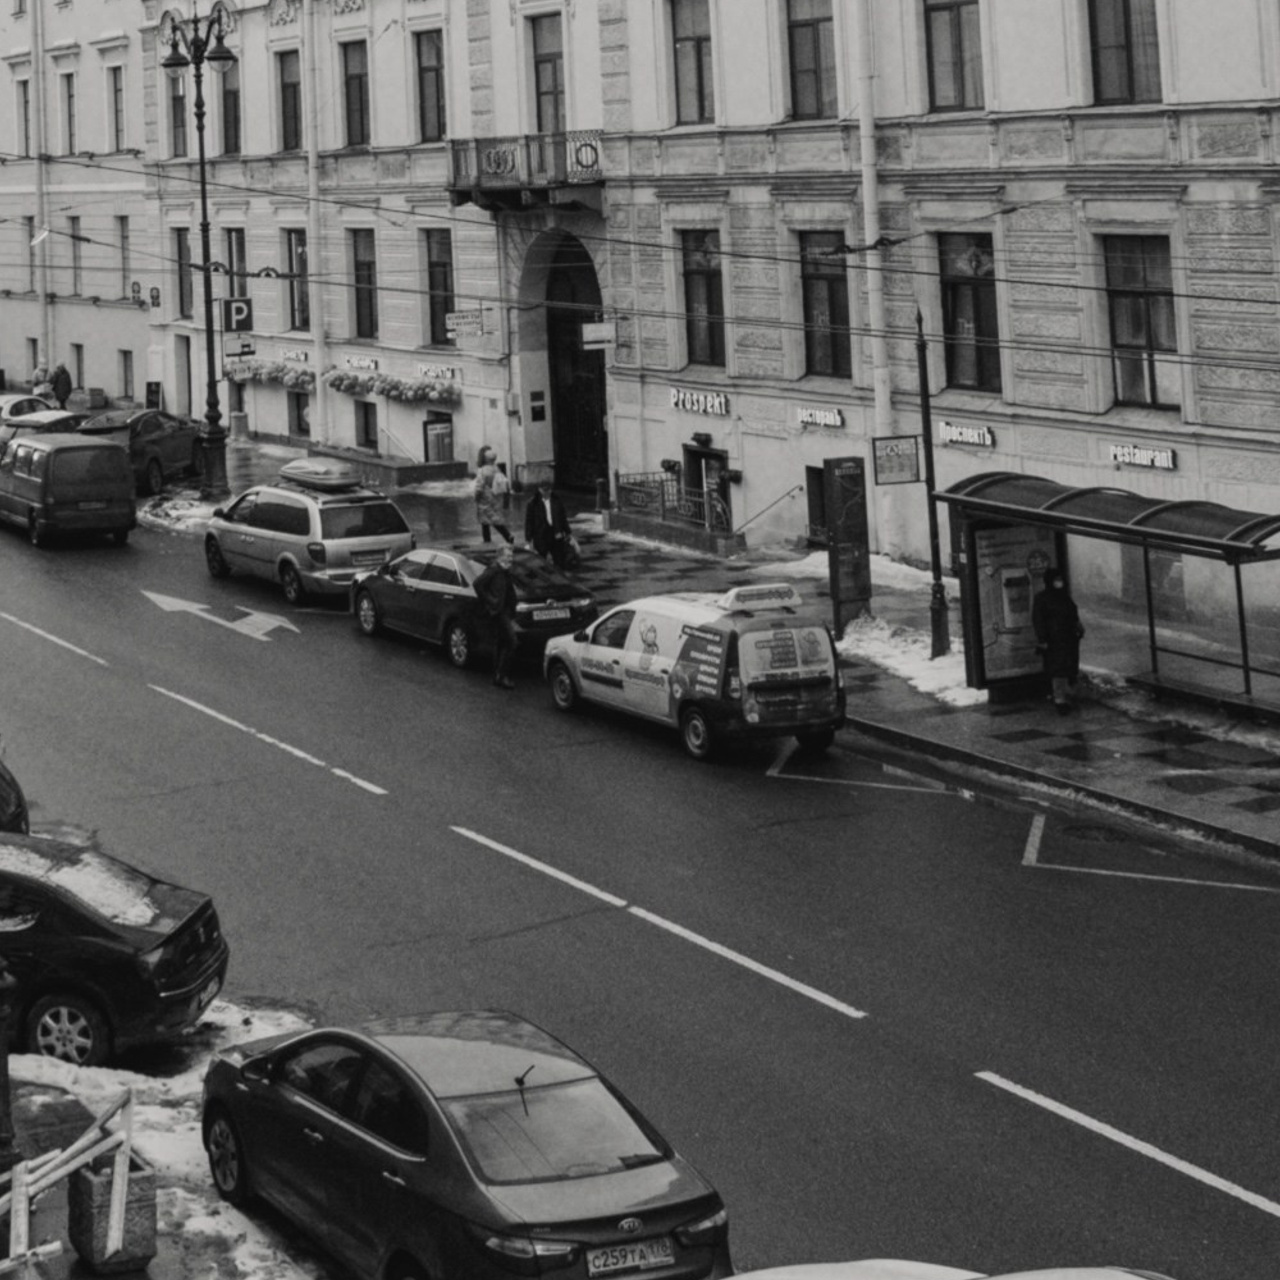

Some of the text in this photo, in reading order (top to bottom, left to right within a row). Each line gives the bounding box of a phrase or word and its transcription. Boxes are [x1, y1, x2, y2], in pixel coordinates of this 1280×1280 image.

[231, 302, 248, 329] P
[670, 387, 727, 415] Prospekt
[1109, 444, 1174, 469] restaurant
